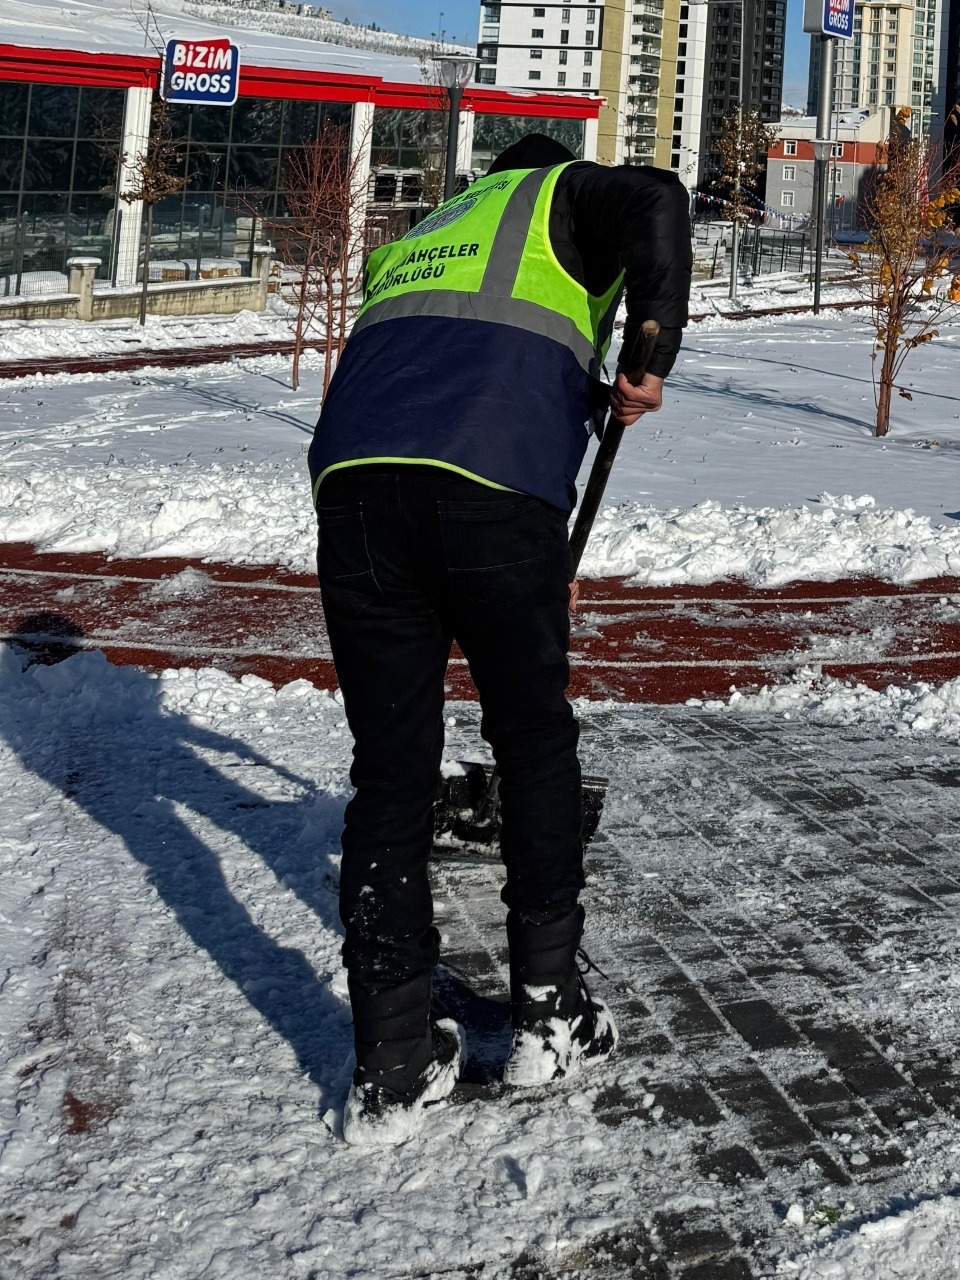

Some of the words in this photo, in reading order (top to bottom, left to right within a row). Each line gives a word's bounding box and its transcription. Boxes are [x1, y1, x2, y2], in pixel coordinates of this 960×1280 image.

[829, 11, 849, 30] GROSS
[170, 71, 231, 94] GROSS
[400, 243, 480, 266] AHÇELER
